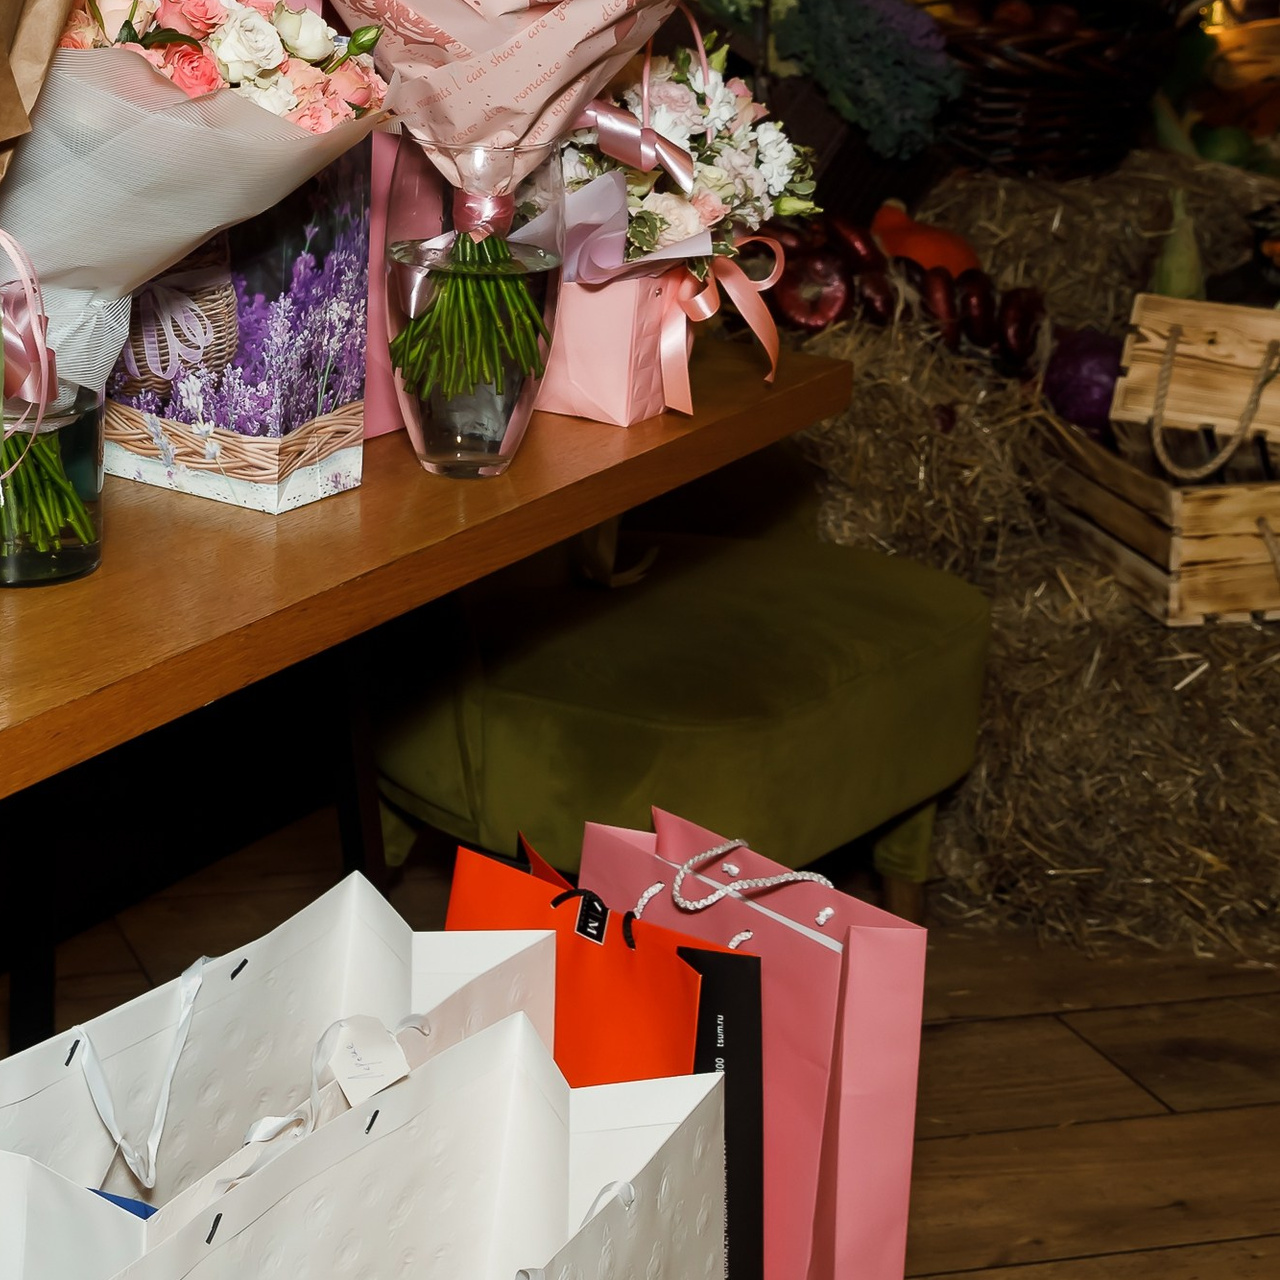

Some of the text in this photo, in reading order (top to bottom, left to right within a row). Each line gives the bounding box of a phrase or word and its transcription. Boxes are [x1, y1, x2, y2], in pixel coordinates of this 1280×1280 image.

[465, 66, 487, 85] can
[490, 40, 523, 68] share
[528, 19, 548, 40] are
[513, 61, 563, 104] romance
[552, 87, 578, 118] upon
[716, 1014, 725, 1048] tsum.ru
